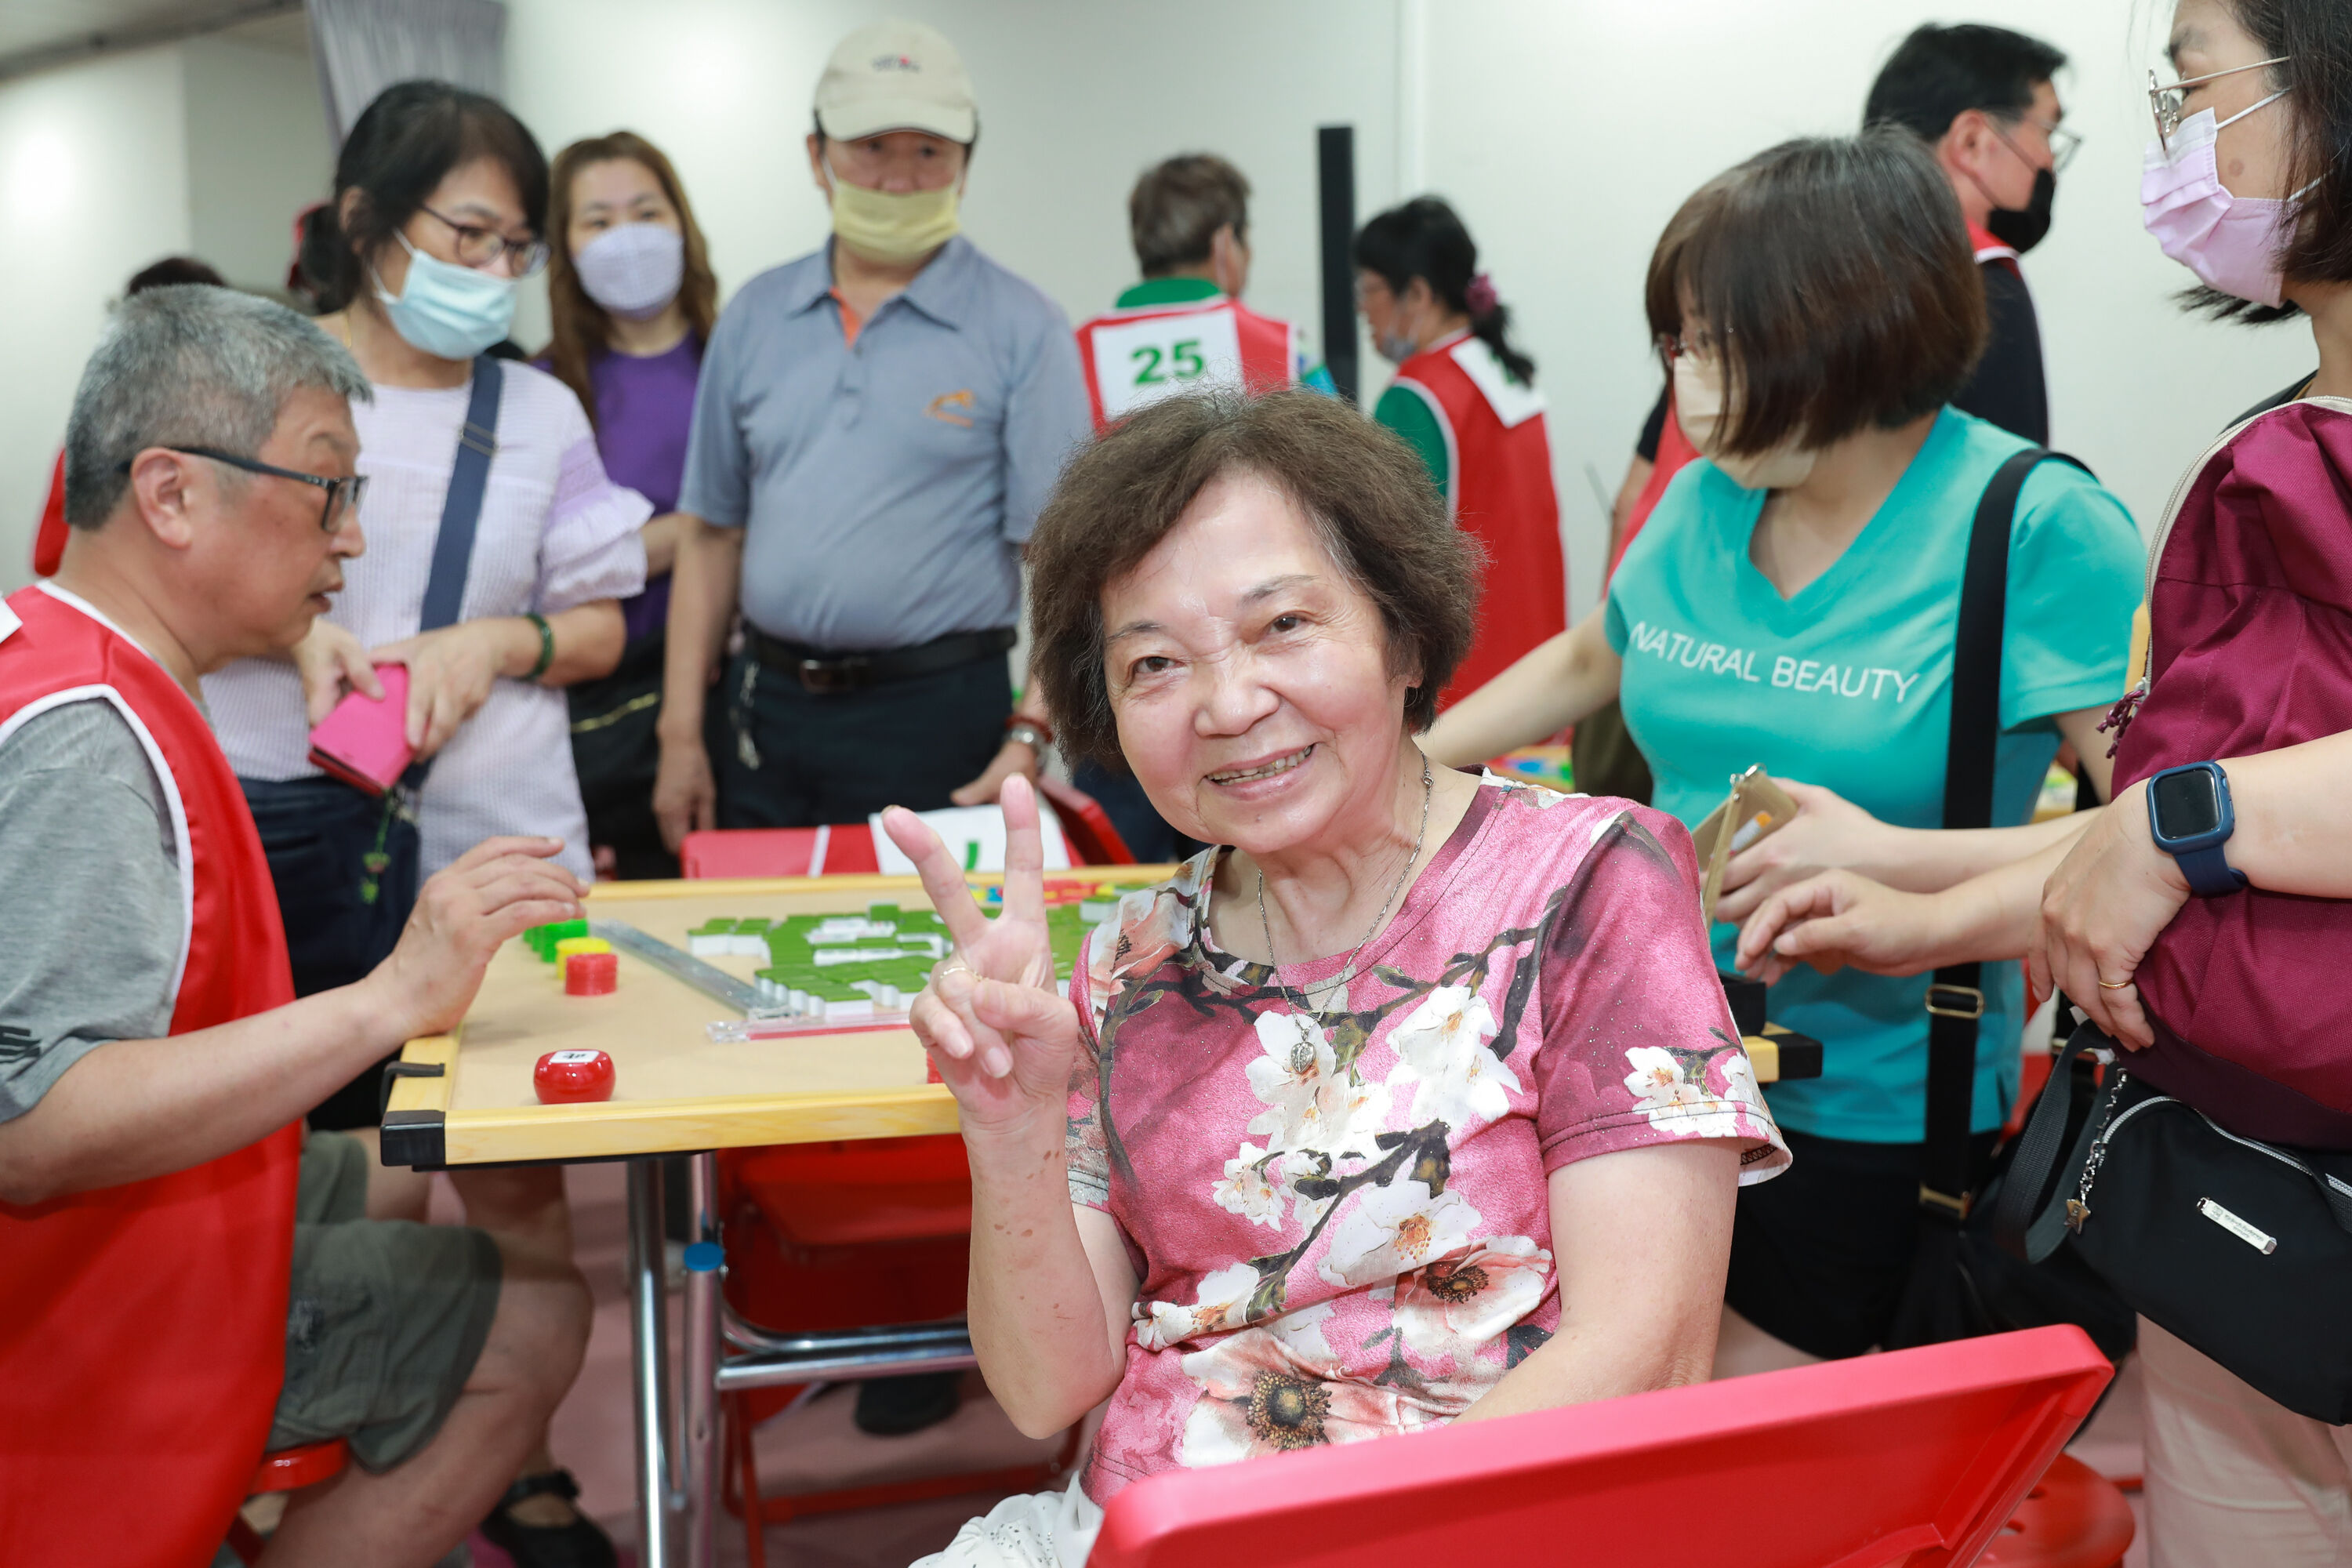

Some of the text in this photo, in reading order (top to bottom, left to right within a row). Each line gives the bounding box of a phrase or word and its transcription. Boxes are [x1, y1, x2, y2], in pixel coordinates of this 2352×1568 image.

[1131, 339, 1204, 384] 25
[1629, 620, 1921, 703] NATURAL BEAUTY
